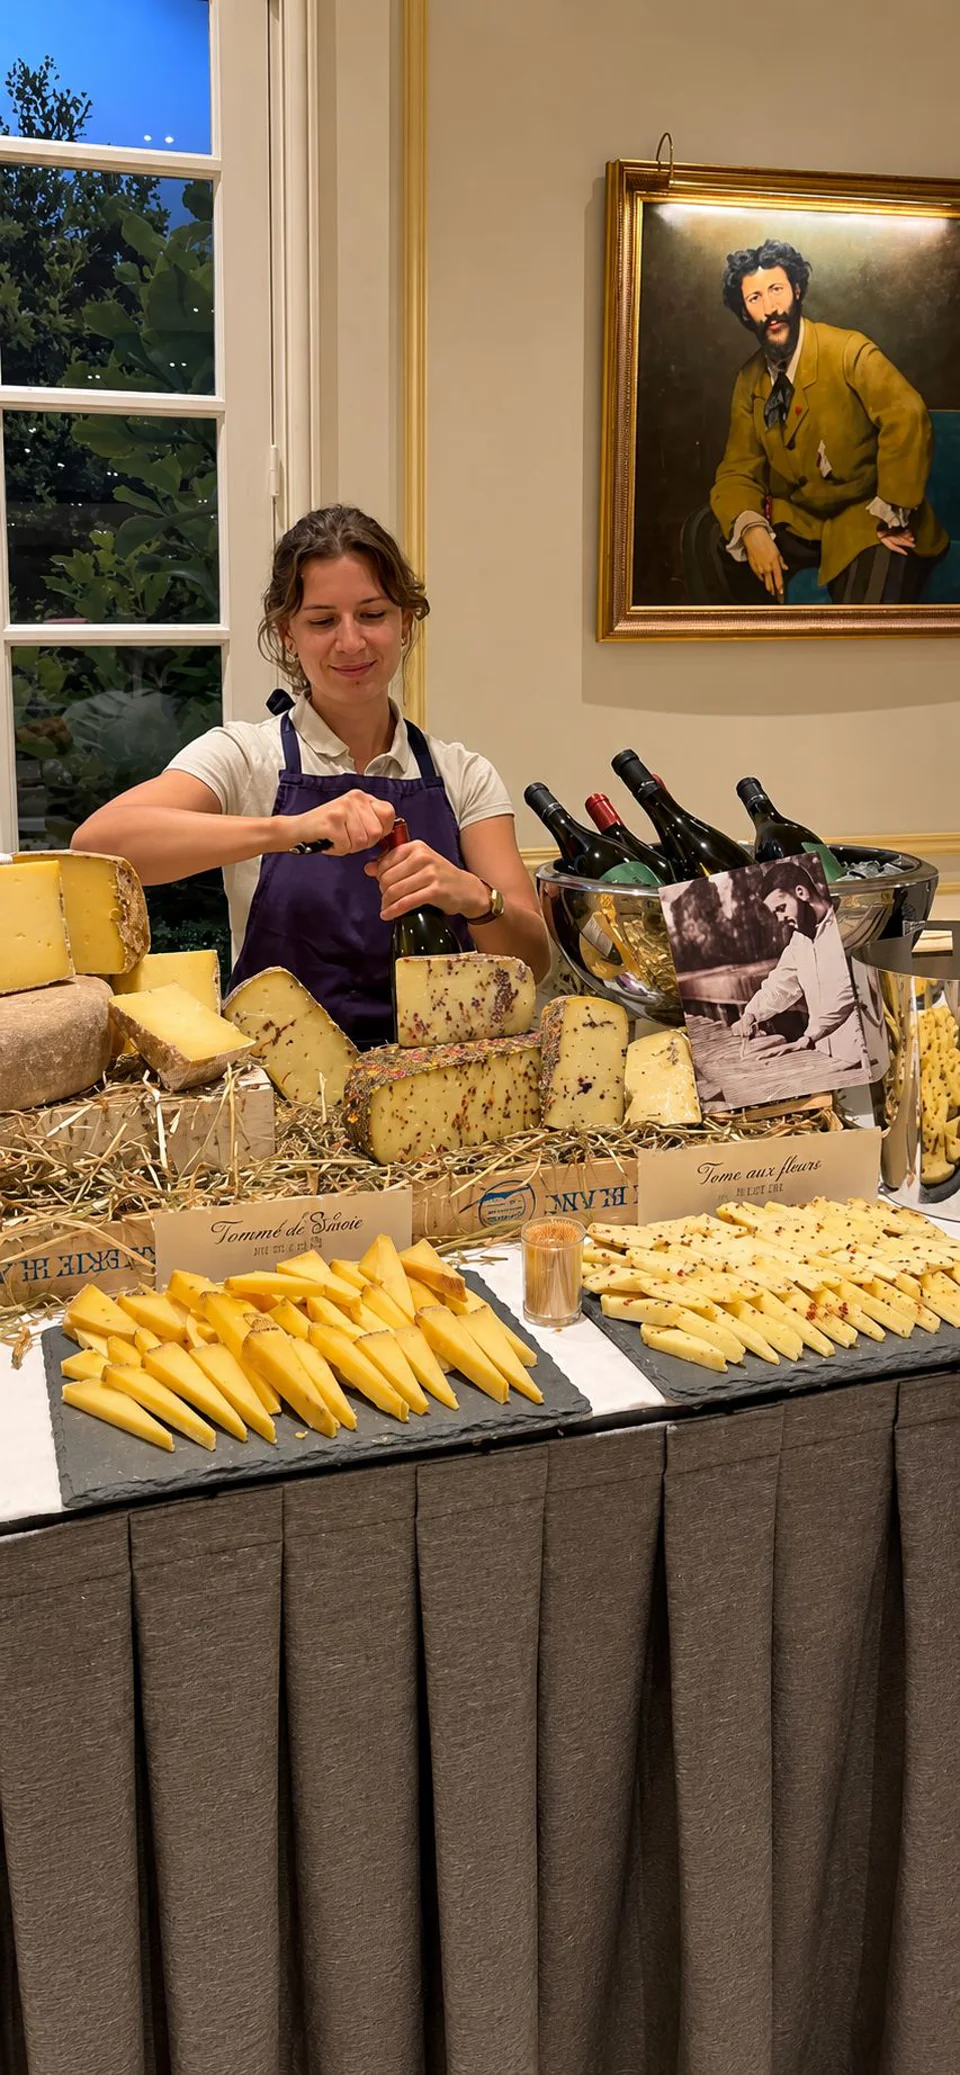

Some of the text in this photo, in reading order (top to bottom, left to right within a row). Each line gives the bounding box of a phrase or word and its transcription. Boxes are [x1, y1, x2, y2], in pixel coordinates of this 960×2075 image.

[697, 1154, 822, 1185] Tome aux fleurs
